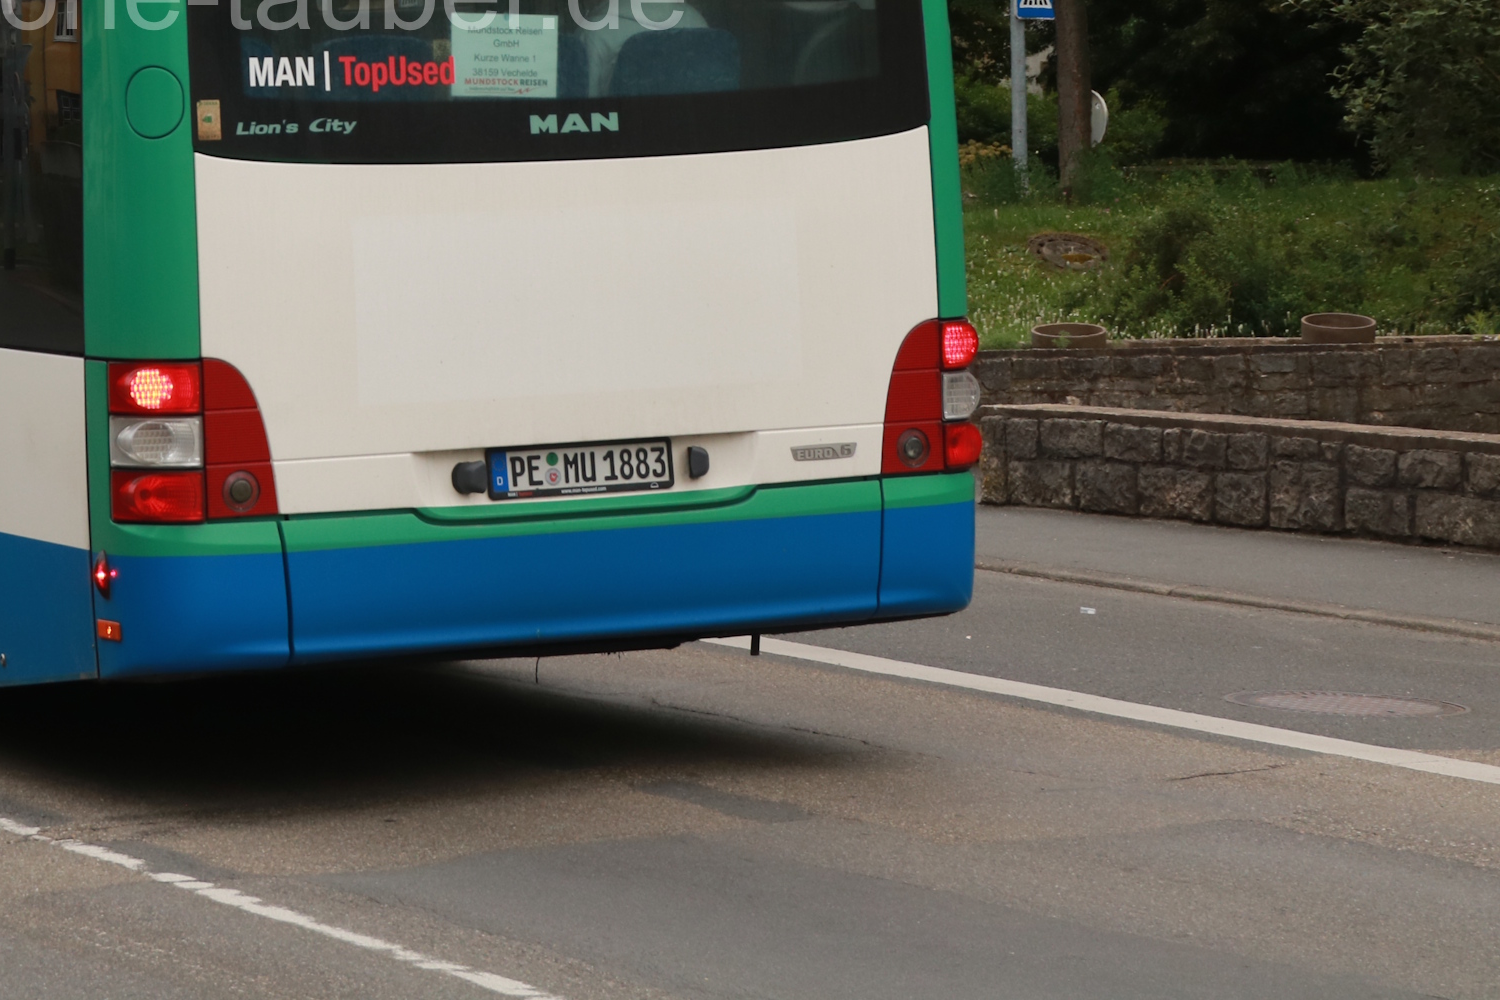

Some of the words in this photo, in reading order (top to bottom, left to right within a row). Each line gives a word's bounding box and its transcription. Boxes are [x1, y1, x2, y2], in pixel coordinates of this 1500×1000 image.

[493, 39, 520, 47] GmbH
[474, 54, 499, 62] Kurze
[501, 54, 530, 63] Wanne
[249, 56, 315, 87] MAN
[338, 55, 455, 93] TopUsed
[501, 69, 538, 77] Vechelde
[236, 119, 299, 136] Lion's
[308, 118, 357, 135] City
[529, 111, 620, 135] MAN
[796, 448, 833, 460] EURO
[840, 444, 852, 456] 6
[509, 455, 544, 487] PE
[563, 451, 596, 484] MU
[602, 446, 666, 481] 1883
